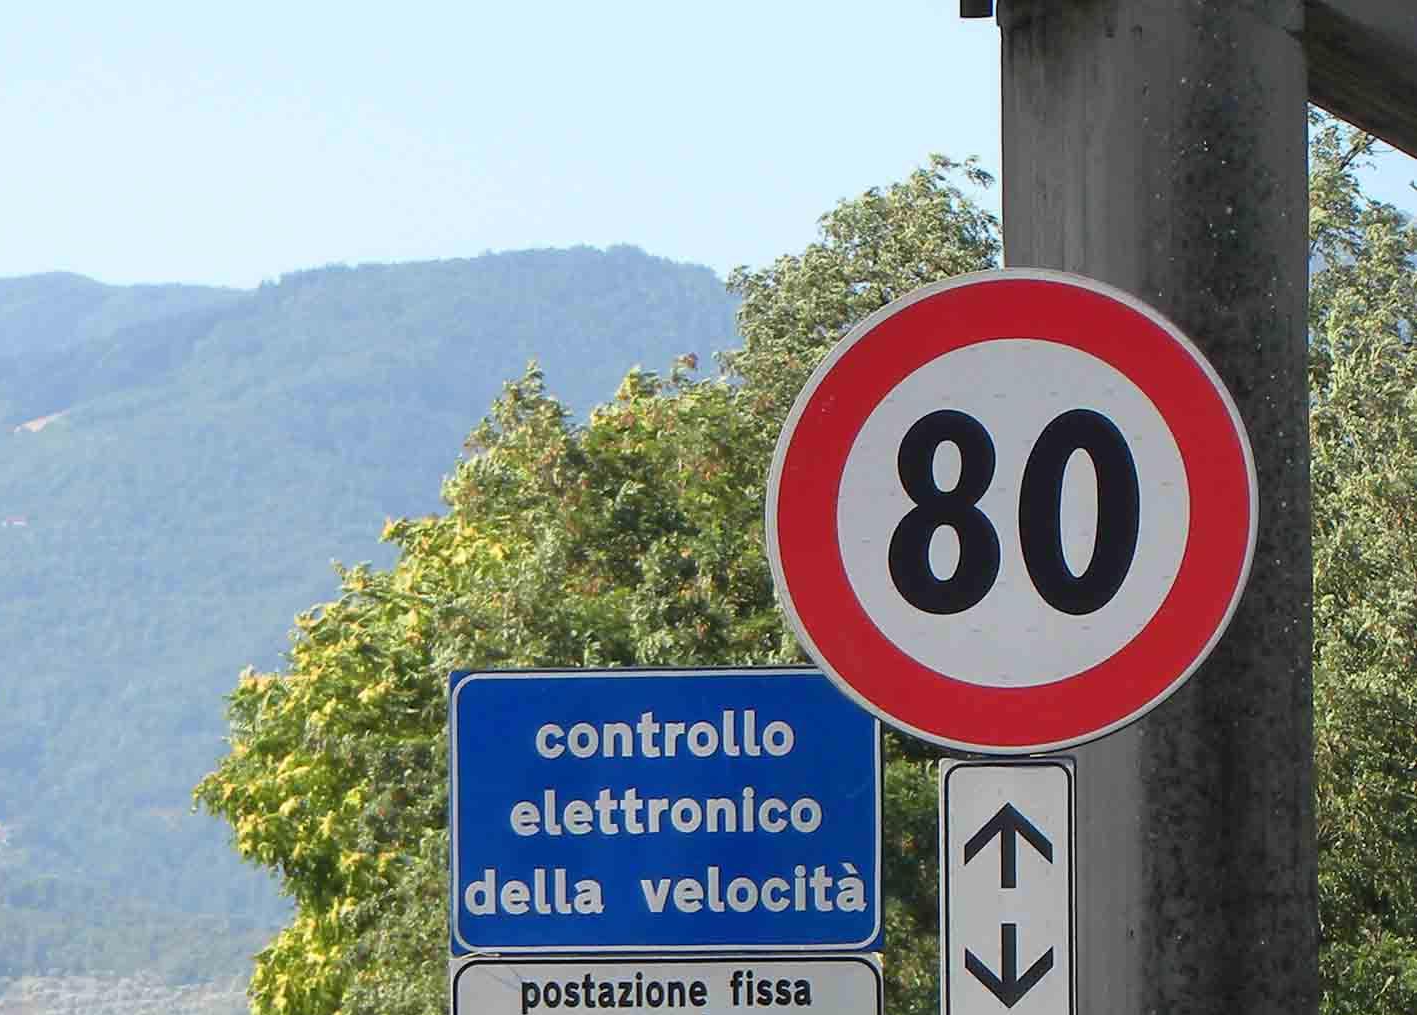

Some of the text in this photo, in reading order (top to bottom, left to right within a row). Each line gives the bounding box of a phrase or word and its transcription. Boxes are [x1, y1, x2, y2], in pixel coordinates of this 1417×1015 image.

[887, 408, 1142, 616] 80
[535, 710, 795, 759] controllo
[510, 787, 823, 836] elettronico
[464, 862, 868, 916] della velocità
[520, 970, 813, 1015] postazione fissa
